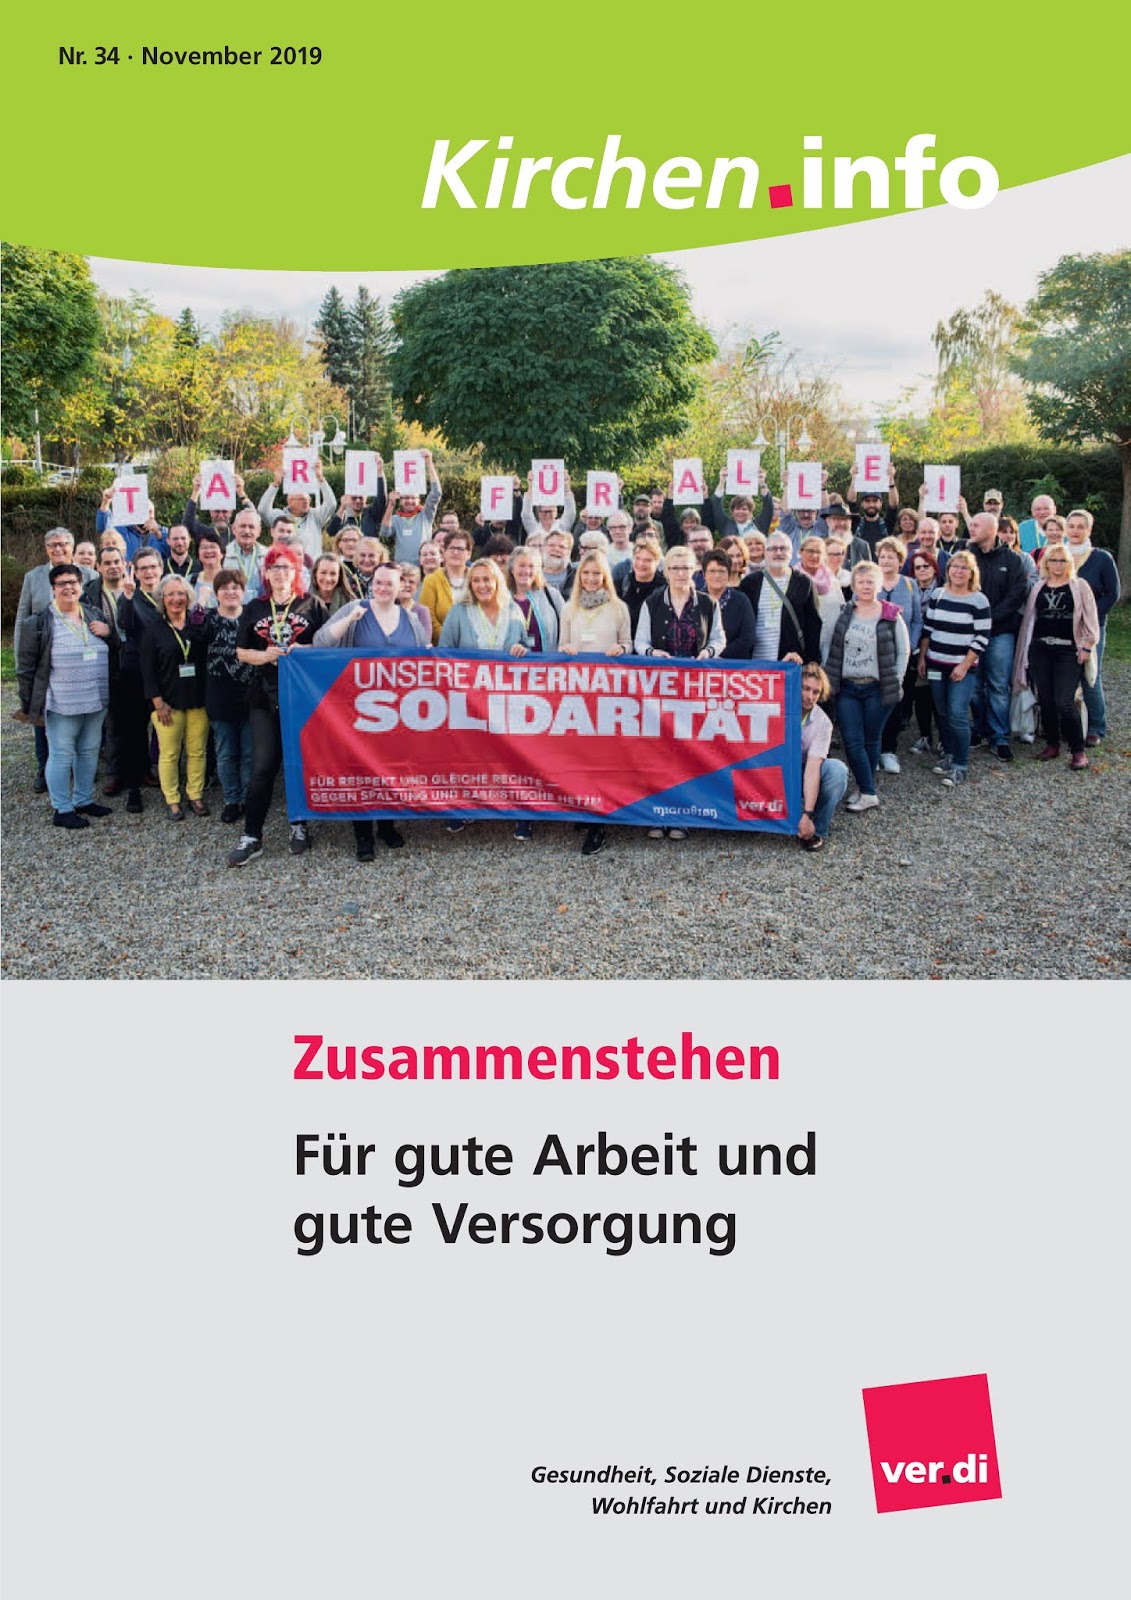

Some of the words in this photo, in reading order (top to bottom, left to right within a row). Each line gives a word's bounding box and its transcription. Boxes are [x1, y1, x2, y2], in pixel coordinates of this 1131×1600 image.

[118, 486, 141, 515] T
[205, 472, 231, 500] A
[290, 458, 310, 485] R
[403, 460, 419, 485] F
[490, 486, 505, 510] F
[538, 464, 559, 497] Ü
[594, 481, 613, 507] R
[677, 469, 700, 495] A
[736, 460, 753, 486] L
[797, 472, 815, 500] L
[864, 455, 882, 483] E
[353, 660, 471, 689] UNSERE
[473, 664, 679, 696] ALTERNATIVE
[684, 671, 781, 701] HEISST
[353, 688, 782, 744] SOLIDARITÄT
[309, 776, 335, 788] FÜR
[338, 776, 396, 787] RESPEKT
[400, 776, 428, 785] UND
[431, 773, 489, 785] GLEICHE
[492, 774, 542, 787] RECHTE
[310, 792, 358, 803] GEGEN
[360, 790, 428, 802] SPALTUNG
[738, 799, 784, 813] ver.di
